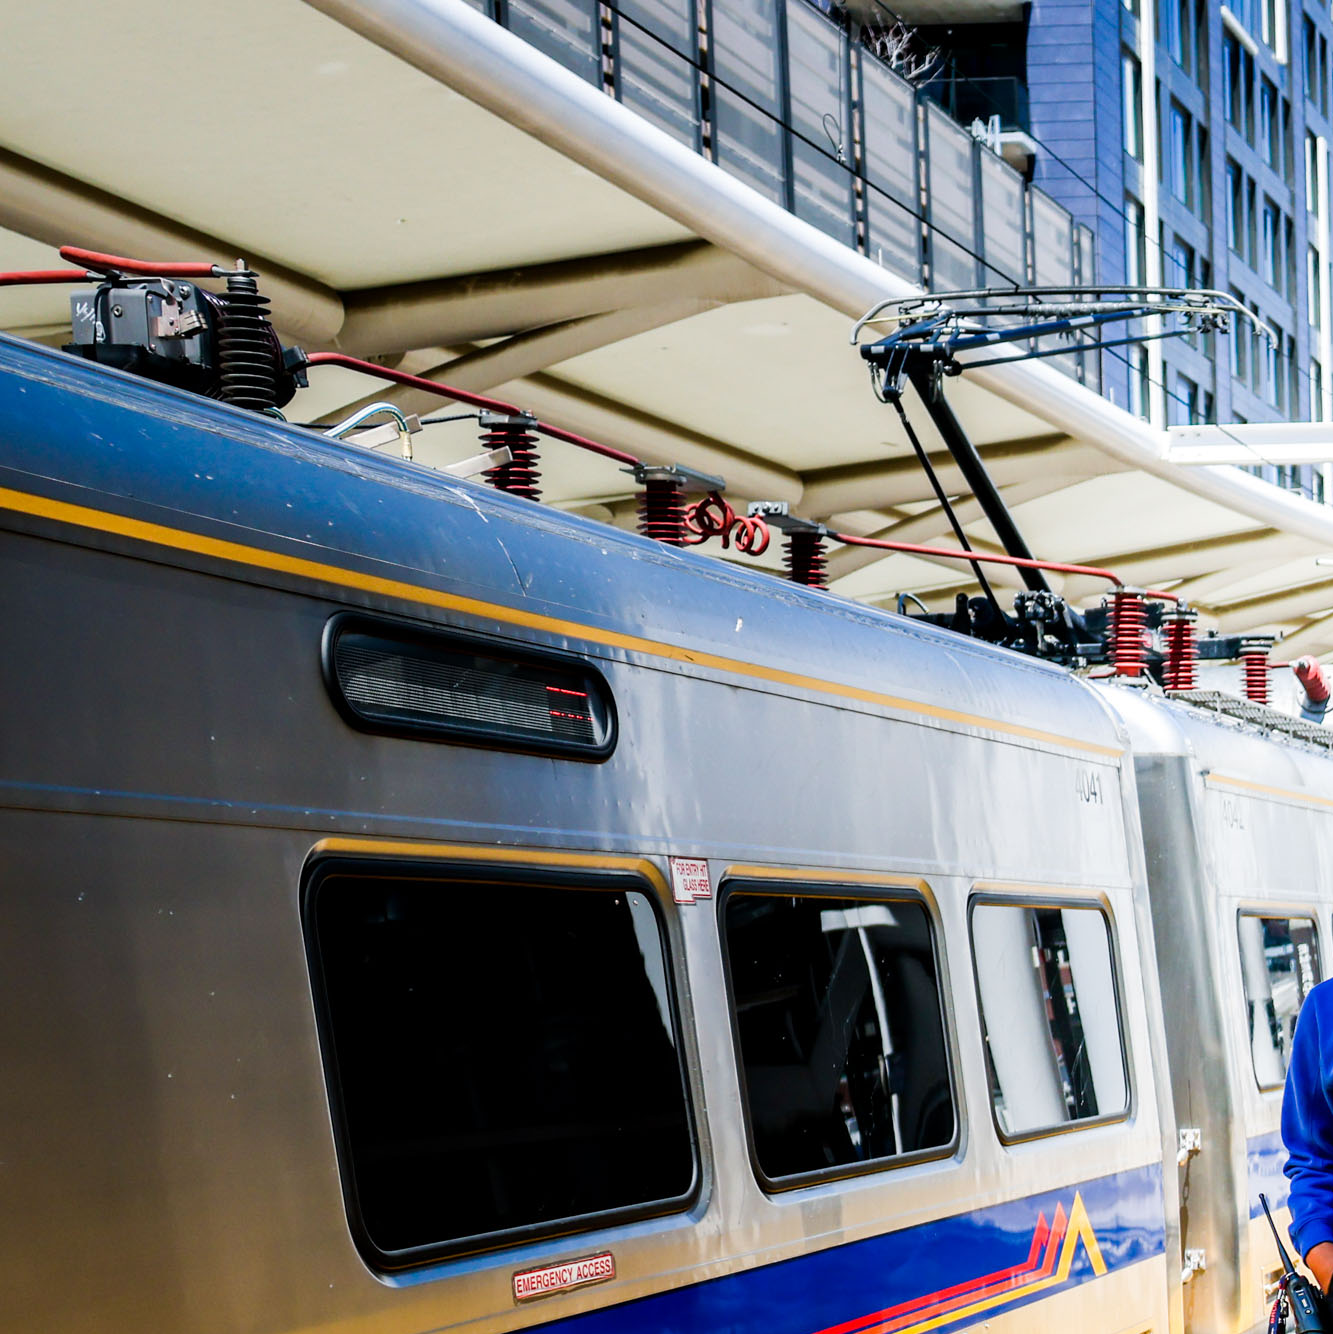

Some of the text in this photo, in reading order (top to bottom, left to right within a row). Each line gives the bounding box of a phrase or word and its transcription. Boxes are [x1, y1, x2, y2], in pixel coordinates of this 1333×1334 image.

[1076, 767, 1103, 805] 4041
[676, 862, 685, 875] FOR
[686, 863, 698, 876] ENTRY
[683, 878, 710, 892] GLASS HERE
[516, 1259, 611, 1293] EMERGENCY ACCESS
